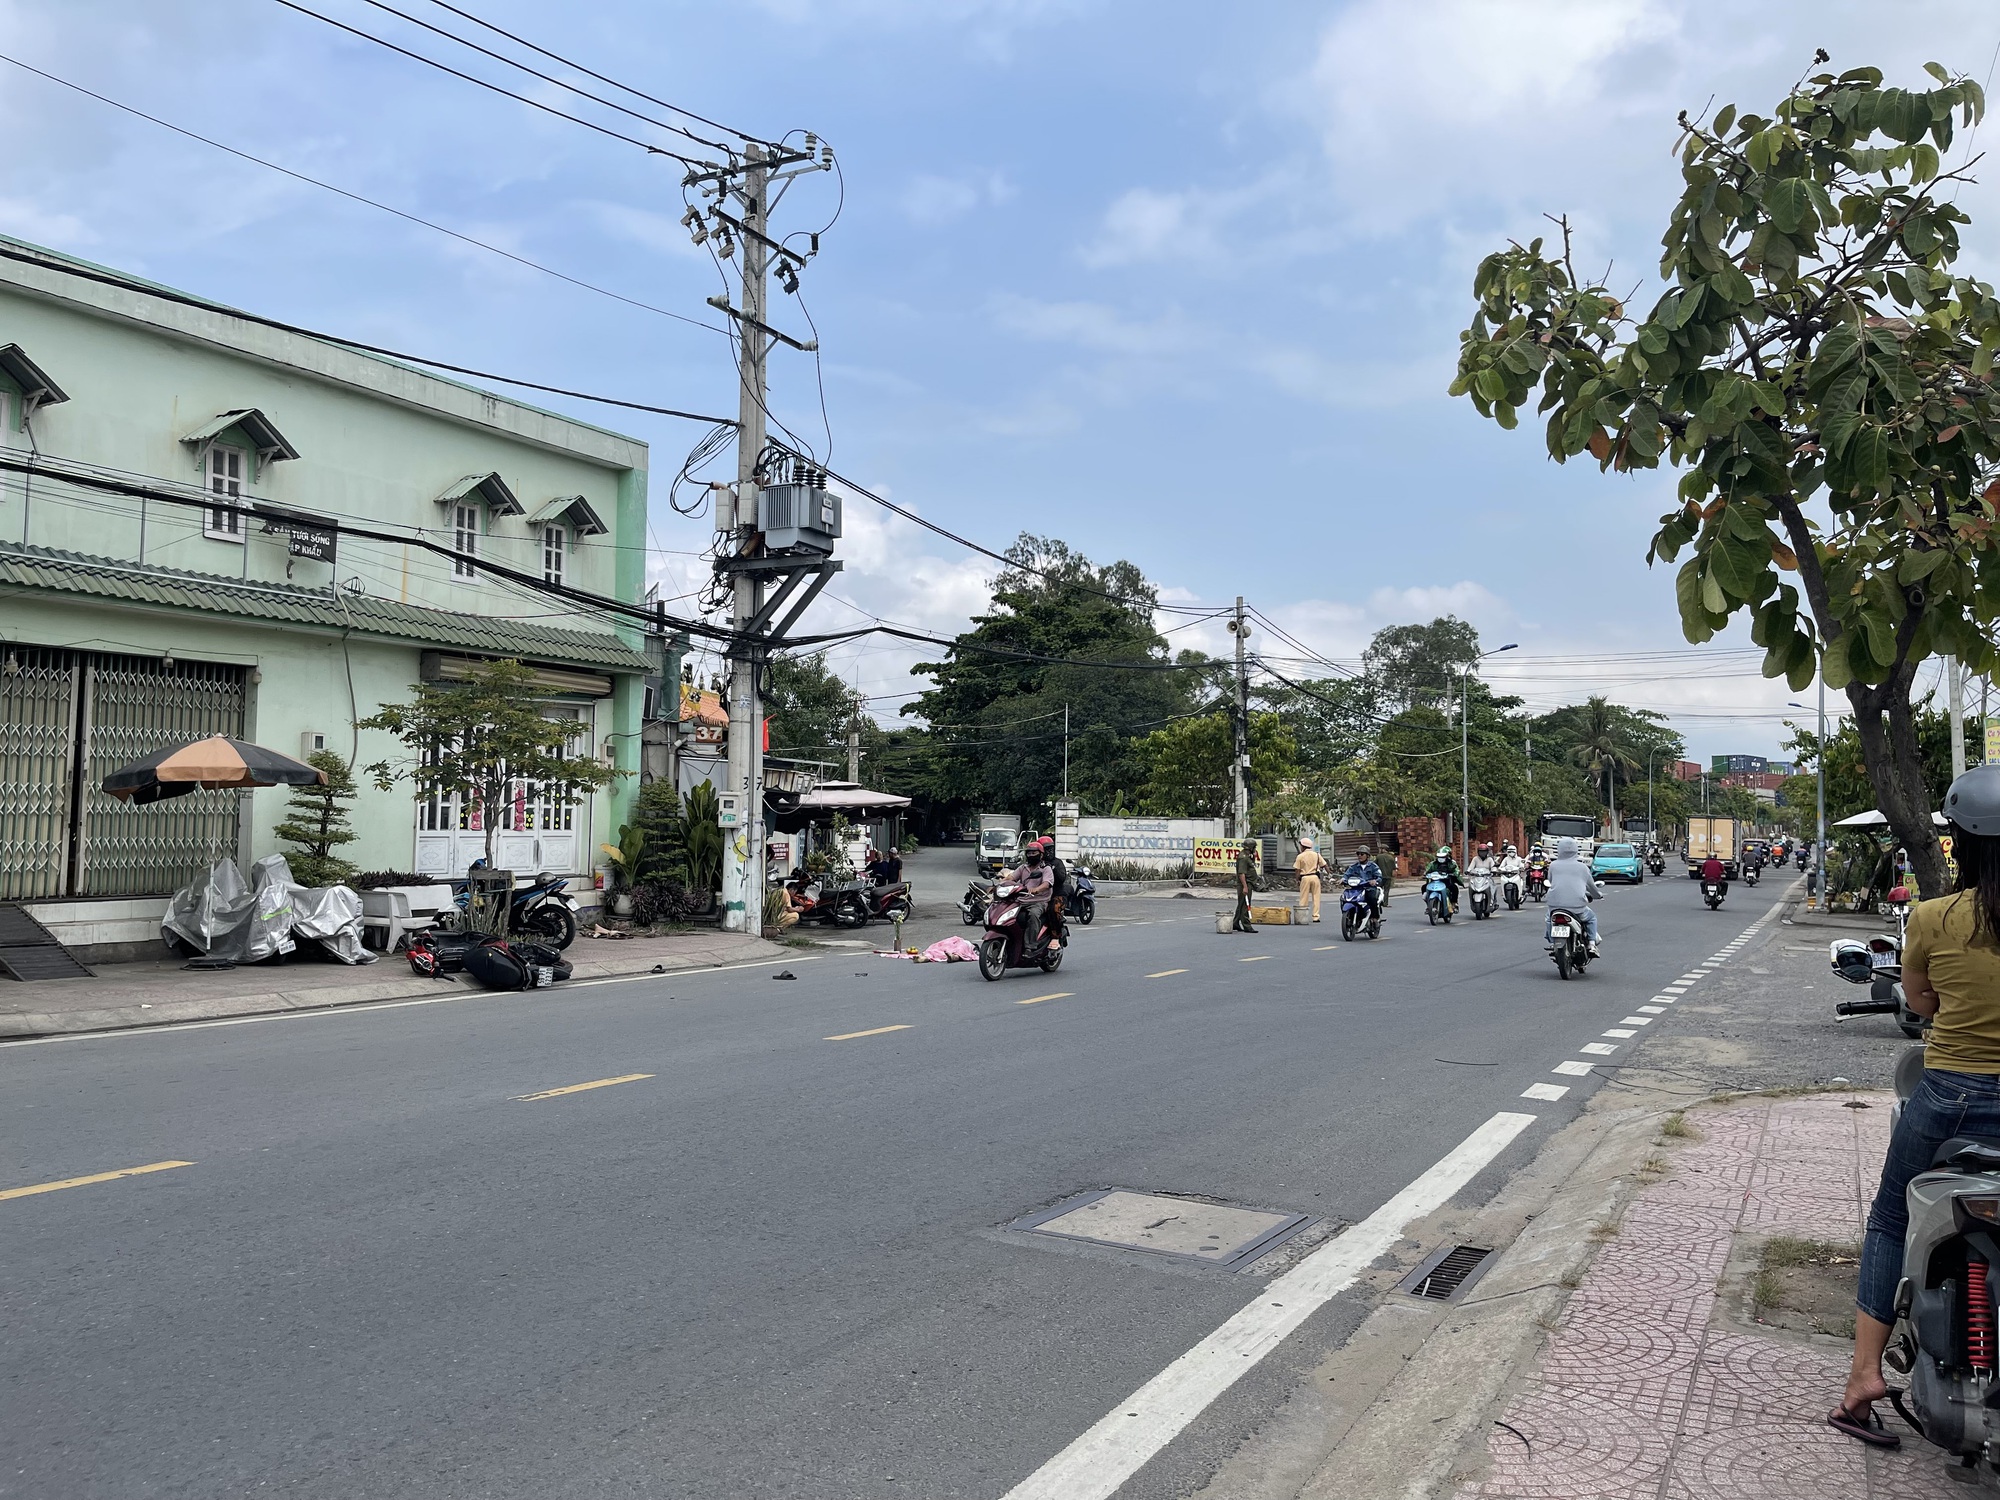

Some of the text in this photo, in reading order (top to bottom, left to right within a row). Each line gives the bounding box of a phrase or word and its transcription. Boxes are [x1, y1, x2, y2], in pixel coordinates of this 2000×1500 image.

[292, 530, 309, 540] TƯƠI
[310, 533, 330, 545] SỐNG
[302, 544, 322, 556] KHẨU
[696, 726, 722, 740] 37
[1127, 834, 1166, 849] CÔNG
[1196, 848, 1222, 860] CƠM
[1226, 848, 1261, 862] TRA
